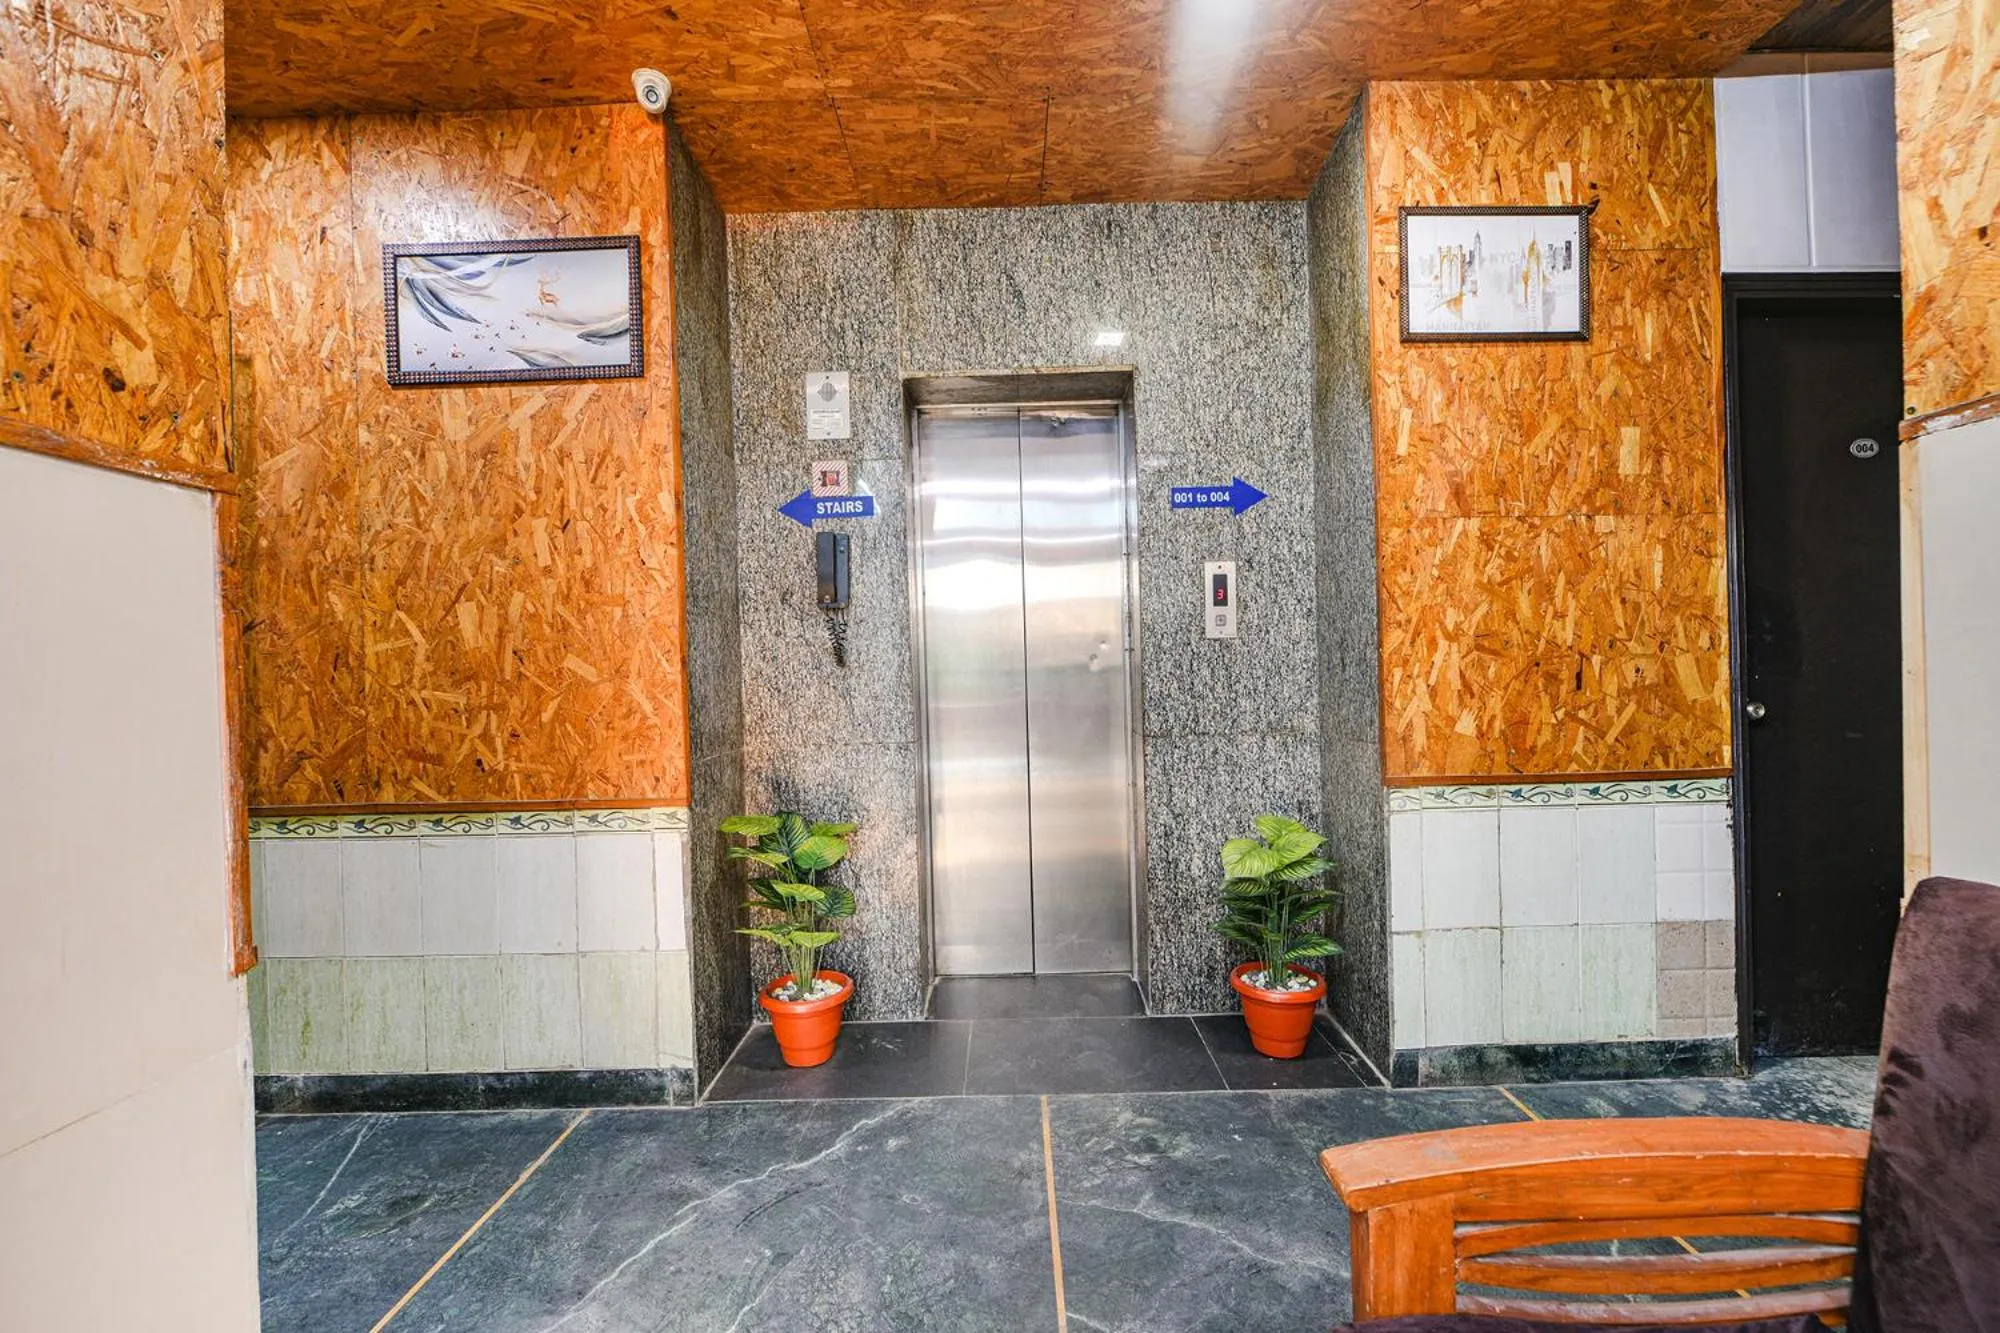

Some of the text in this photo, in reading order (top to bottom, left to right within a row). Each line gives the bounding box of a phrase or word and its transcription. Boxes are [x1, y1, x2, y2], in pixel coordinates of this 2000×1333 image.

[1855, 443, 1874, 453] 004
[1174, 491, 1230, 503] 001 to 004
[816, 500, 863, 514] STAIRS
[1216, 589, 1224, 599] 3
